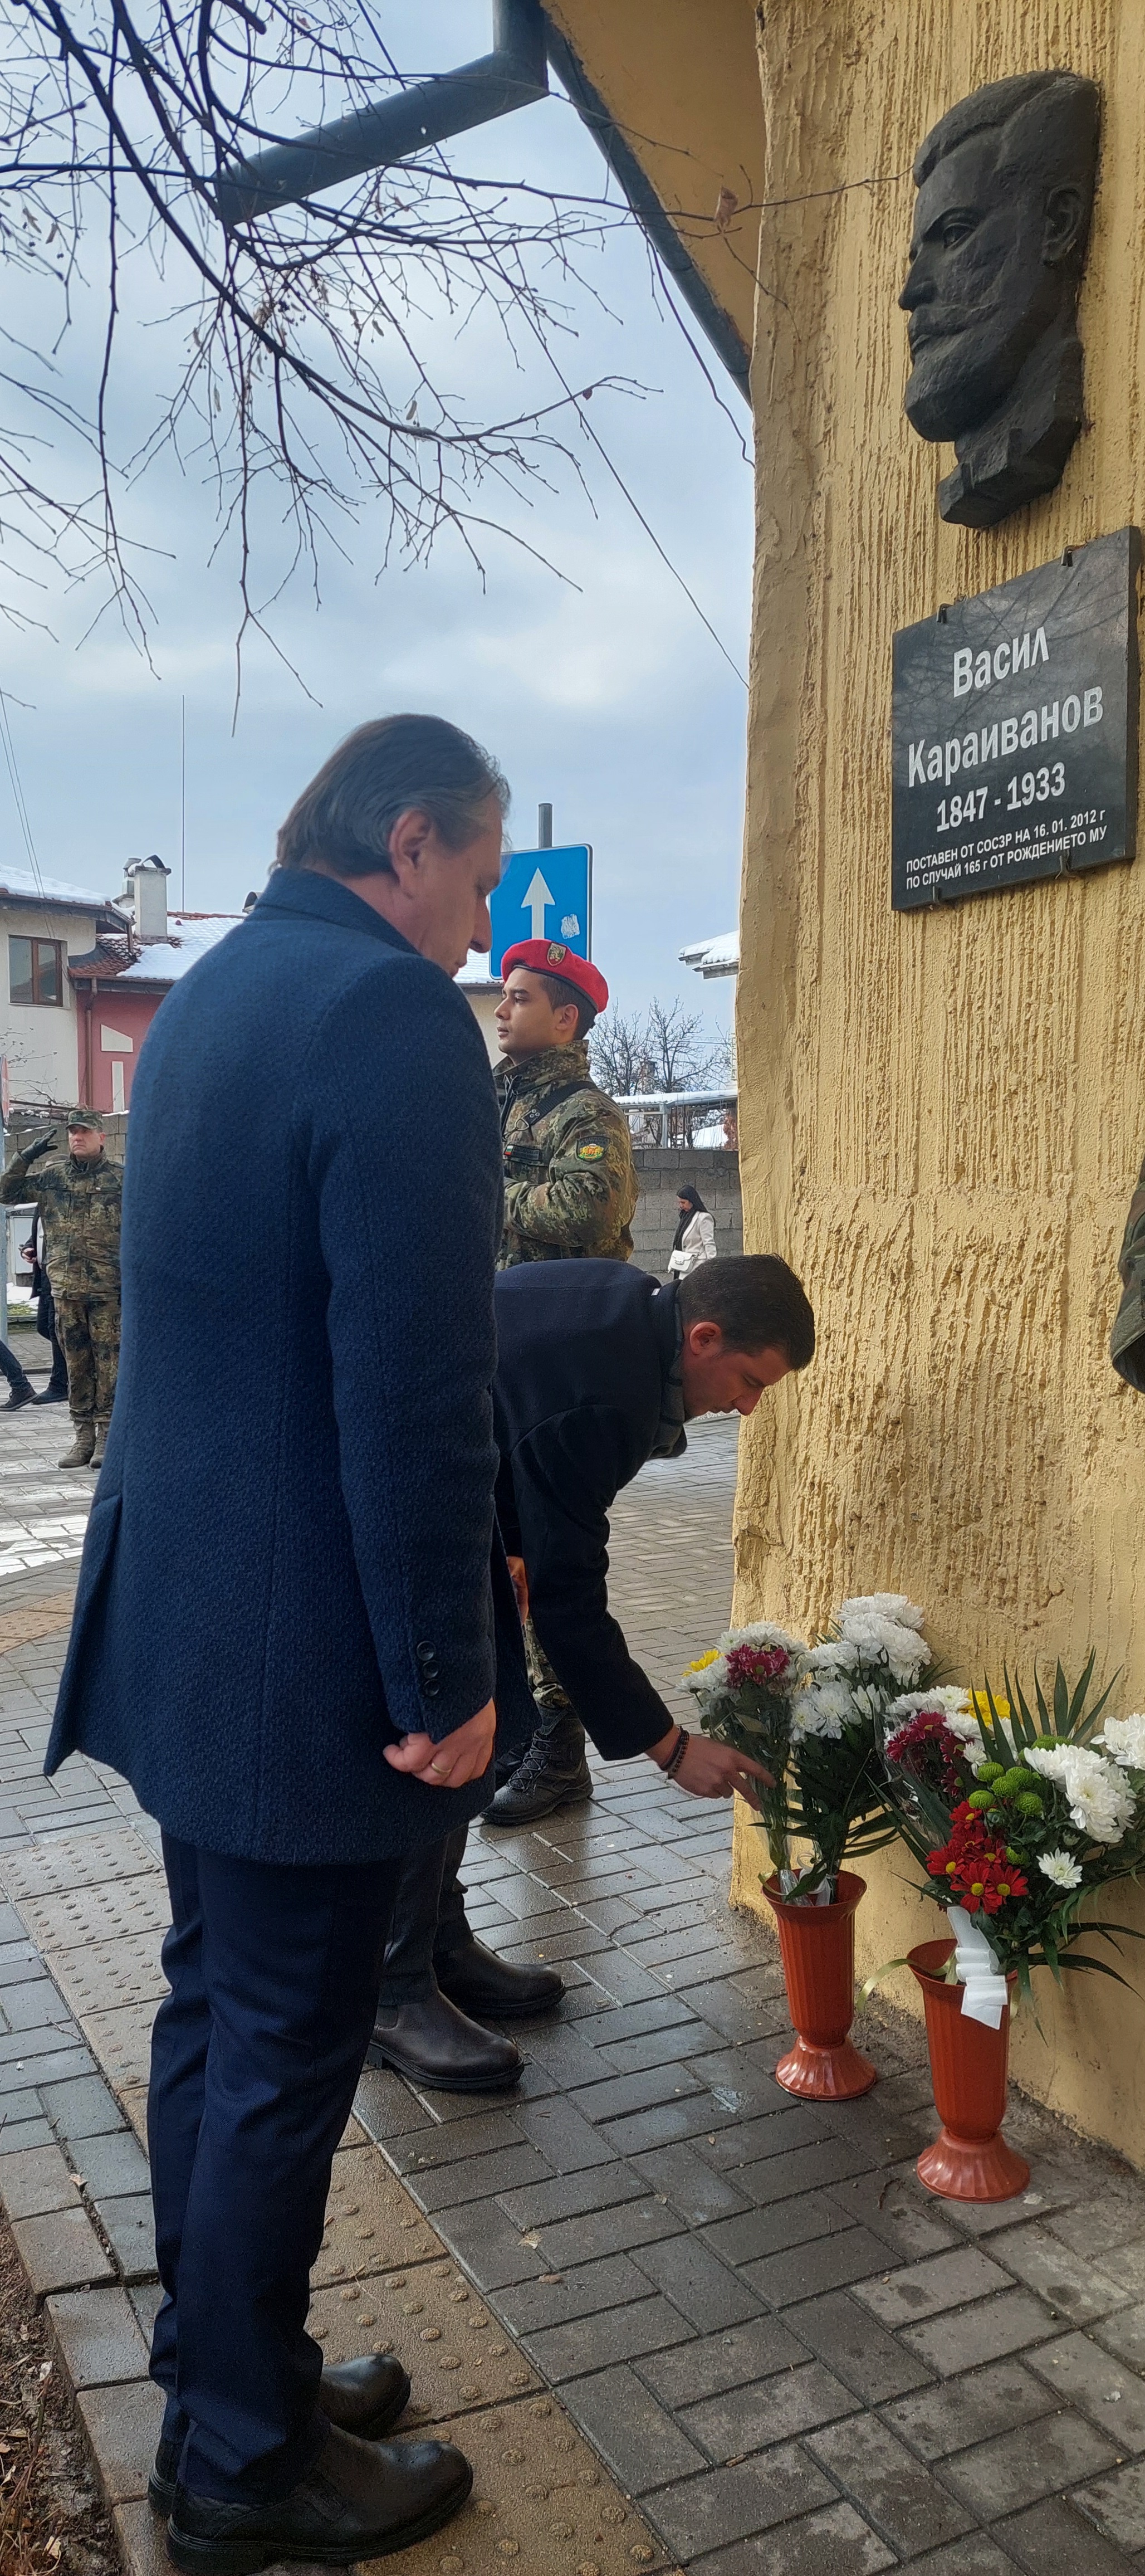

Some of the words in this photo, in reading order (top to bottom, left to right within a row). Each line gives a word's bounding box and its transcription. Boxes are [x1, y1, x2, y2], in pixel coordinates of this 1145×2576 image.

[953, 626, 1049, 697] Васил
[908, 686, 1103, 788] Караиванов
[937, 786, 988, 832] 1847
[1007, 762, 1065, 811] 1933
[906, 848, 958, 873] ПОСТАВЕН
[960, 843, 975, 858] ОТ
[977, 833, 1012, 853] СОСЗР
[1015, 828, 1030, 844] НА
[1034, 823, 1049, 838] 16.
[1052, 818, 1068, 833] 01.
[1070, 809, 1097, 829] 2012
[1099, 809, 1105, 821] г
[906, 876, 920, 890] ПО
[922, 862, 961, 886] СЛУЧАЙ
[963, 859, 980, 875] 165
[983, 860, 988, 870] г
[990, 853, 1005, 869] ОТ
[1007, 832, 1086, 864] РОЖДЕНИЕТО
[1089, 825, 1108, 843] МУ
